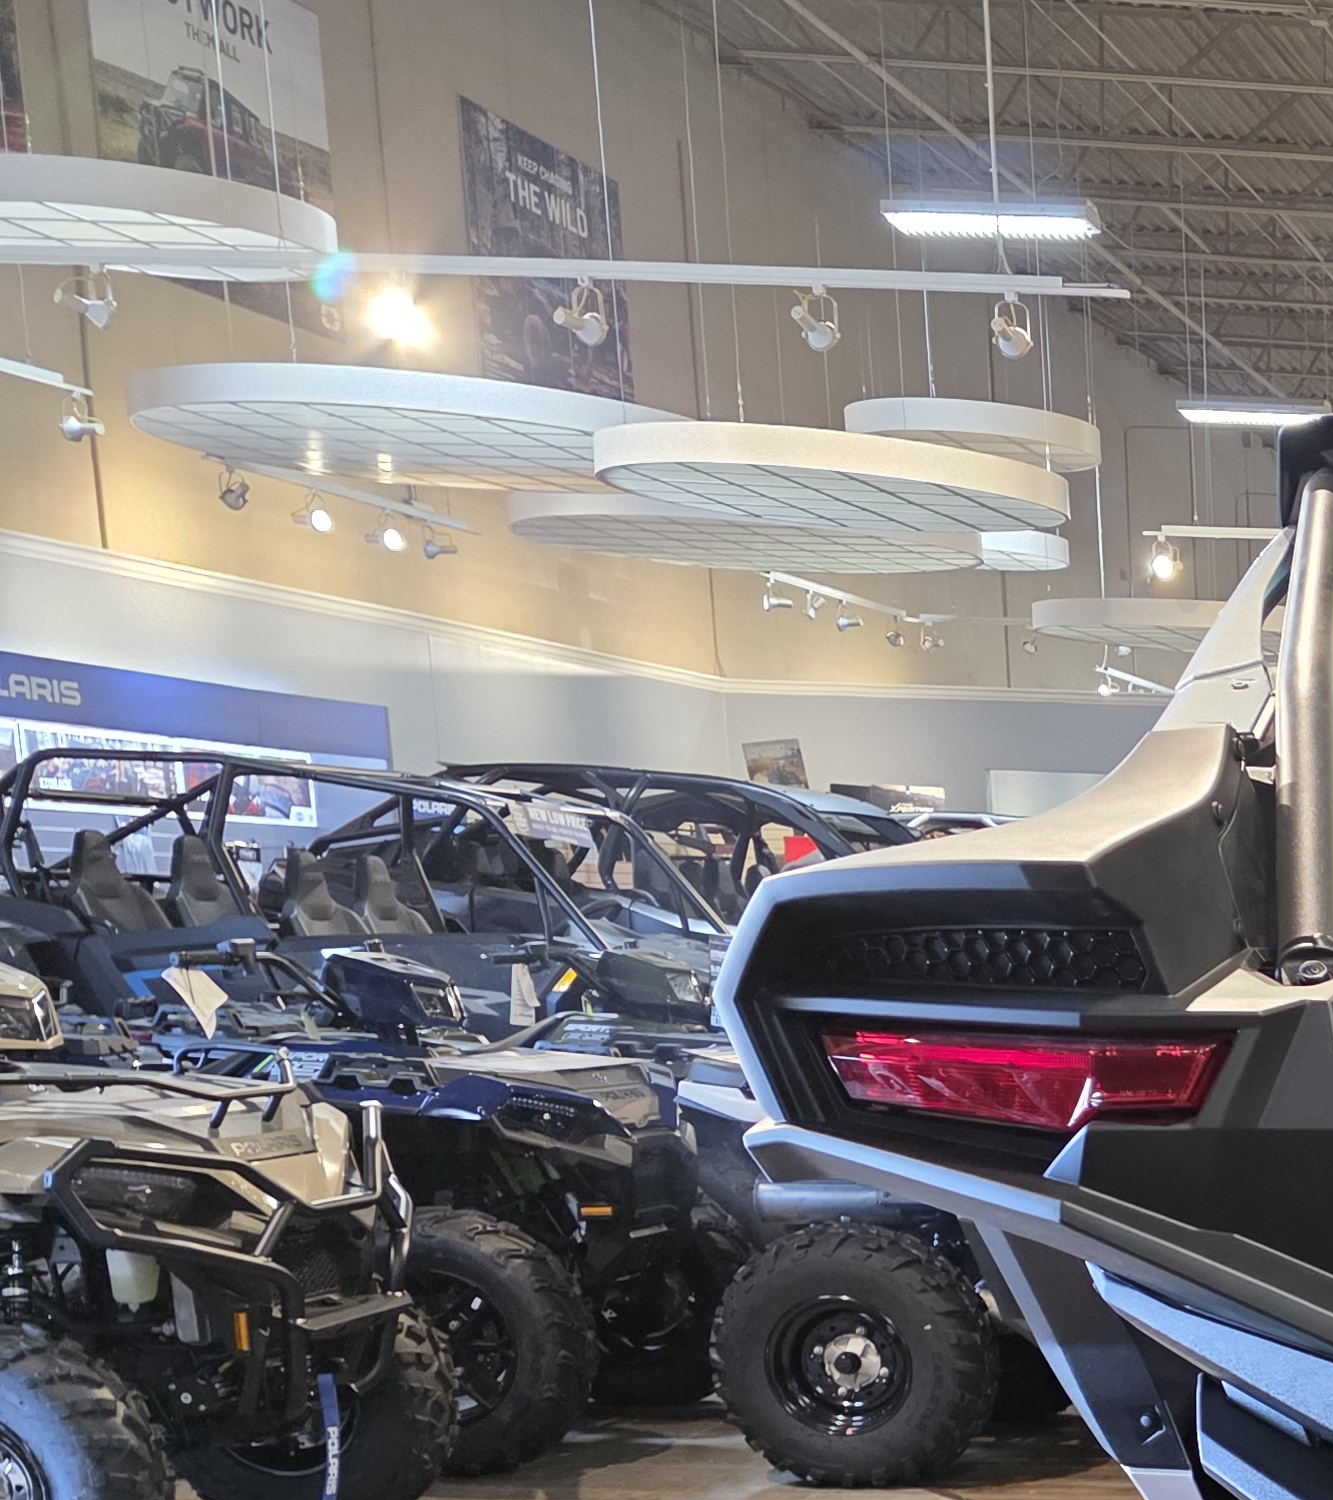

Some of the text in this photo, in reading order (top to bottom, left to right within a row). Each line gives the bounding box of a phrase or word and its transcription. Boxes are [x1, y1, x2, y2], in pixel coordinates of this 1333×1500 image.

[517, 153, 539, 175] KEEP
[505, 169, 588, 238] THE WILD
[527, 805, 547, 822] NEW
[548, 809, 566, 826] LOW
[230, 1133, 303, 1157] POLARIS
[326, 1426, 339, 1496] POLARIS
